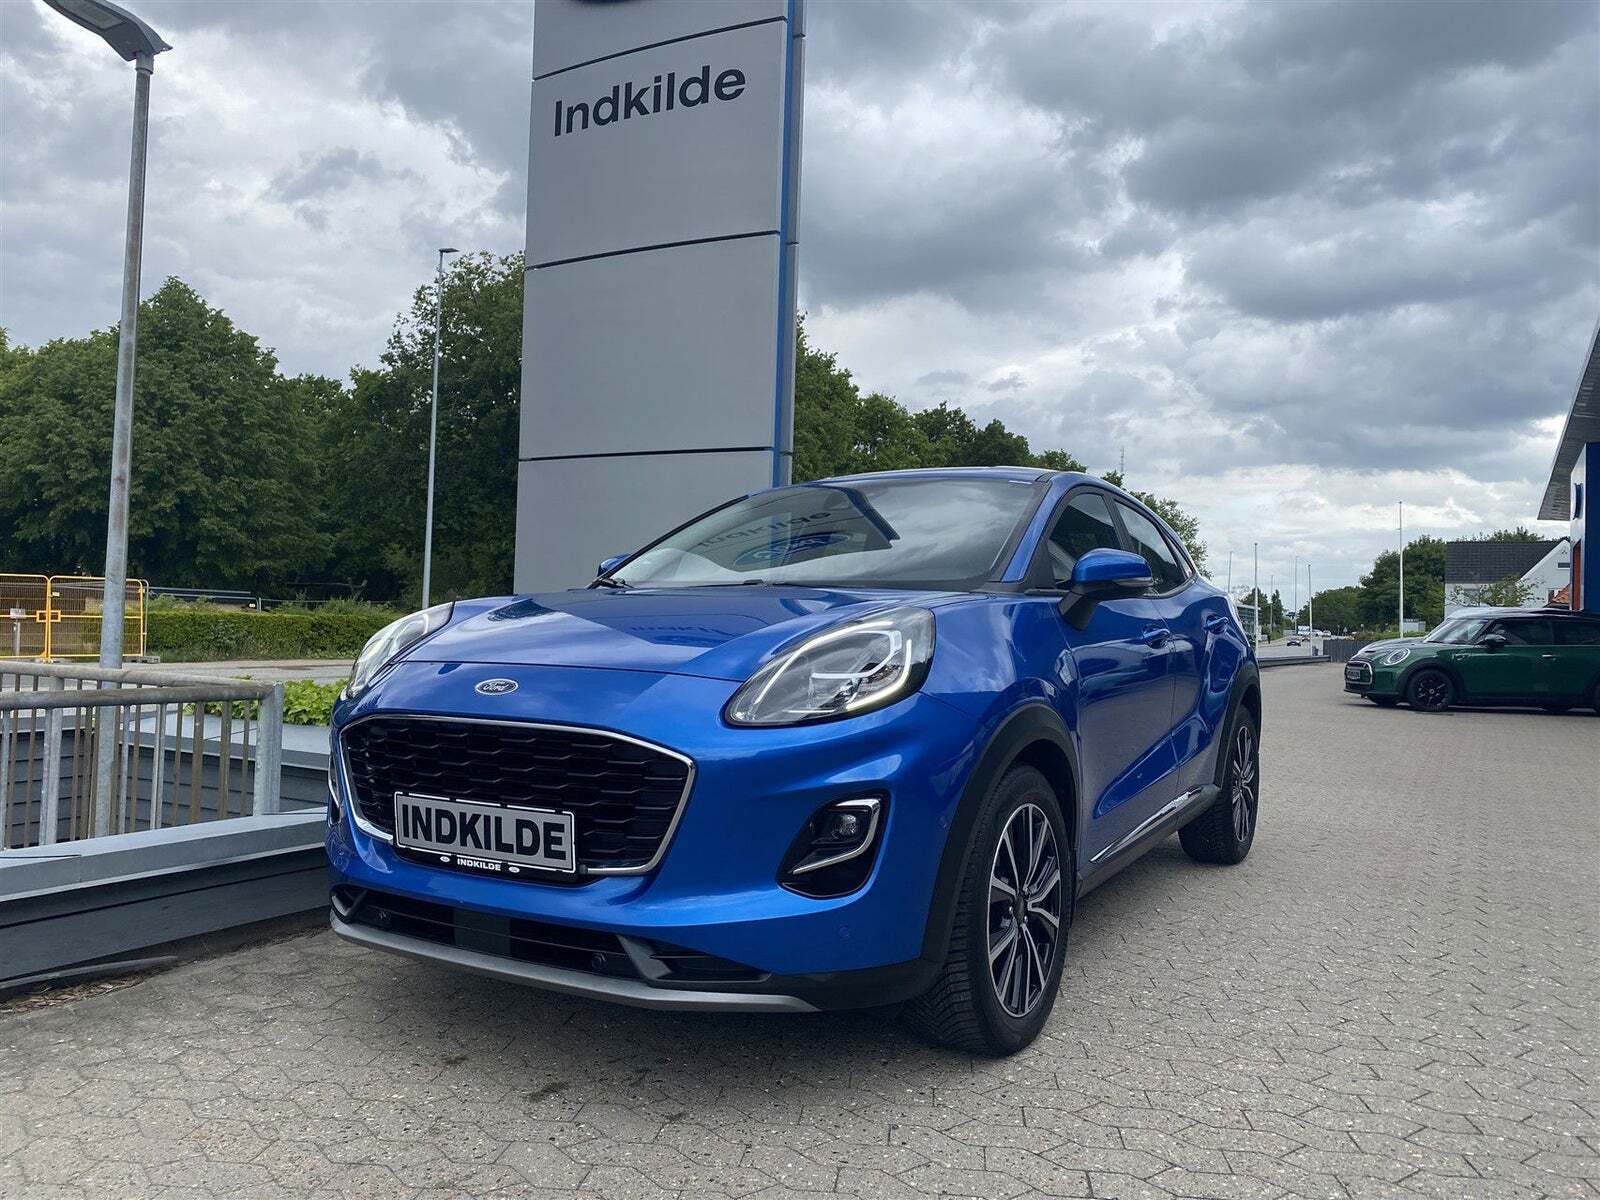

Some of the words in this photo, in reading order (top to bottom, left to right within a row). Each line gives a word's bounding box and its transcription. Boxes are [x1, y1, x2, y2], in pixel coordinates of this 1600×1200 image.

[553, 65, 746, 137] Indkilde
[402, 804, 567, 861] INDKILDE
[457, 858, 501, 871] INDKILDE
